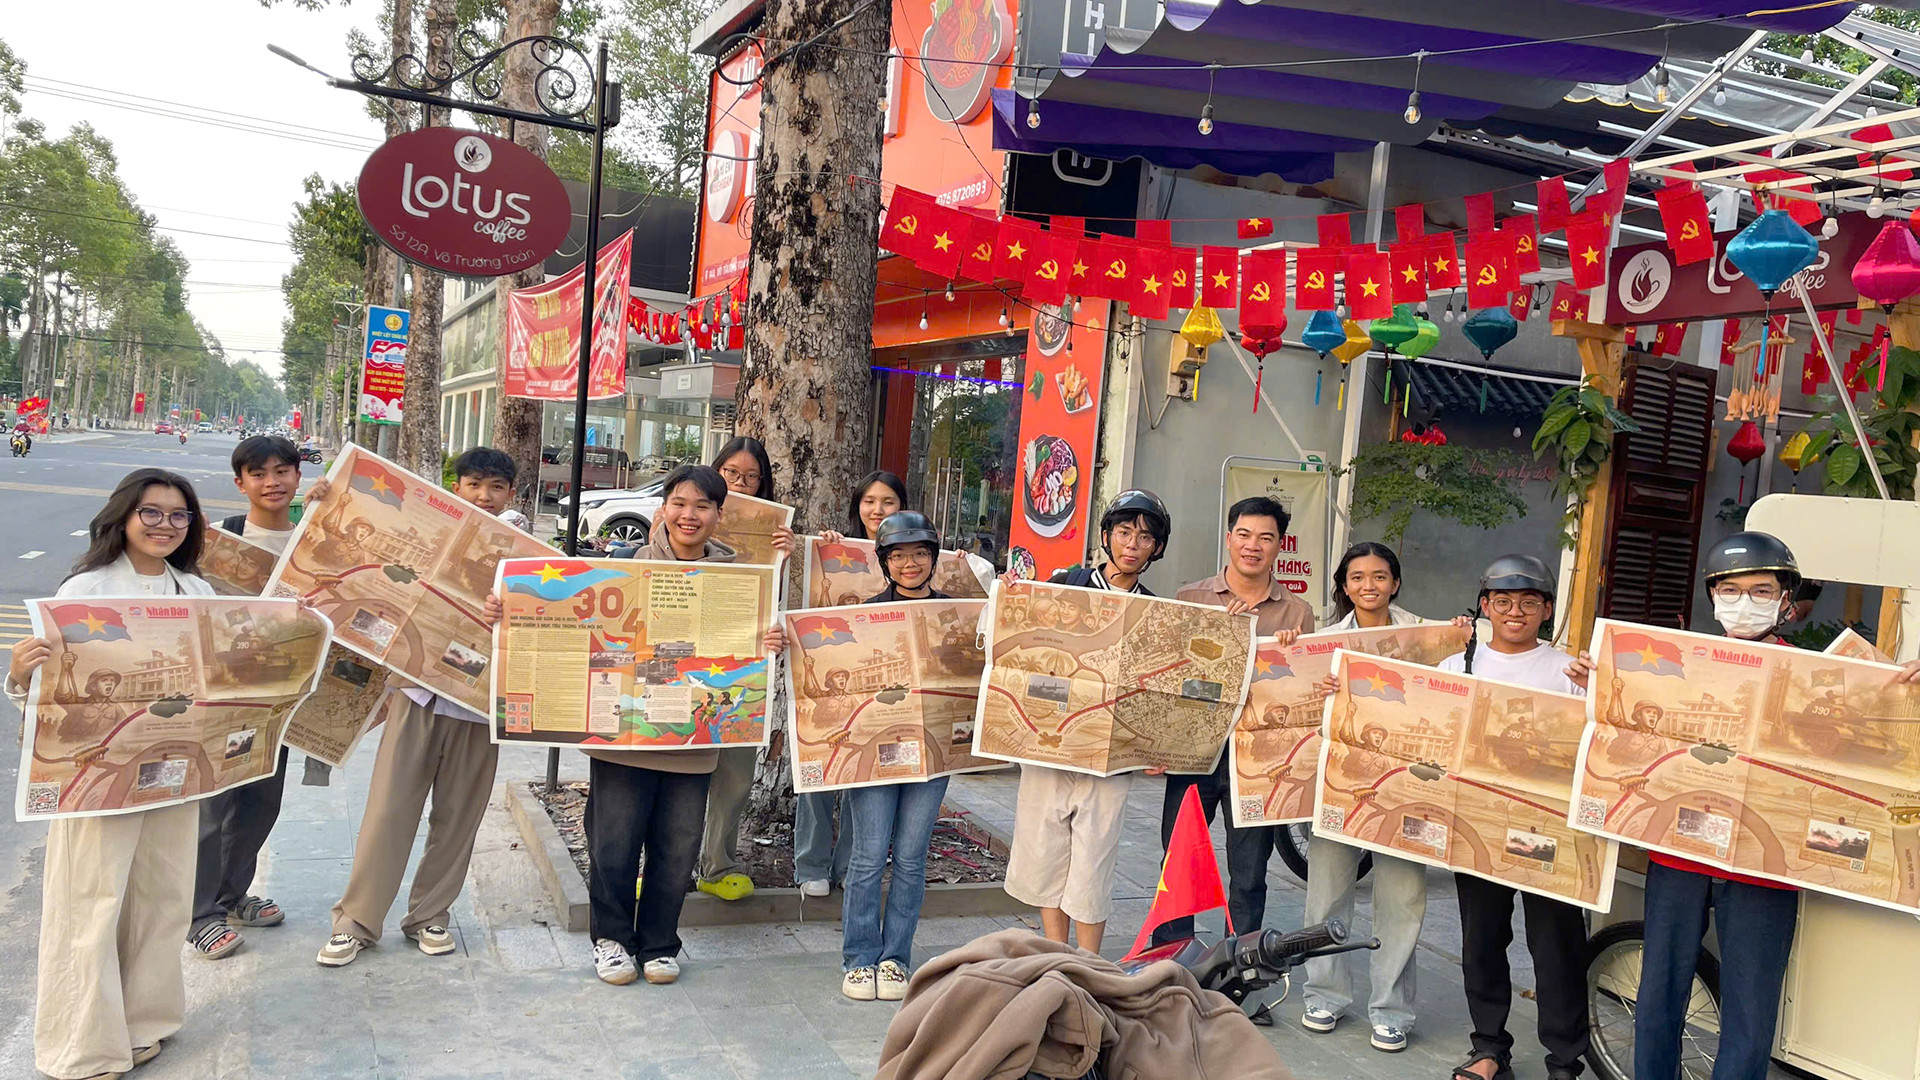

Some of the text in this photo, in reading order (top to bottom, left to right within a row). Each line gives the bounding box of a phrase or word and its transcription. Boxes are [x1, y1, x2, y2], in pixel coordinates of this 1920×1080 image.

[401, 162, 531, 225] Lotus
[952, 179, 987, 203] 8720893
[388, 223, 405, 241] Số
[473, 219, 528, 244] coffee
[427, 494, 464, 519] Nhân Dân
[146, 606, 189, 617] Nhân Dân
[869, 611, 905, 622] Nhân Dân
[236, 641, 250, 650] 390
[1306, 641, 1344, 654] Nhân Dân
[1711, 648, 1763, 667] Nhân Dân
[1428, 677, 1469, 695] Nhân Dân
[1811, 705, 1831, 716] 390
[1507, 729, 1522, 739] 390
